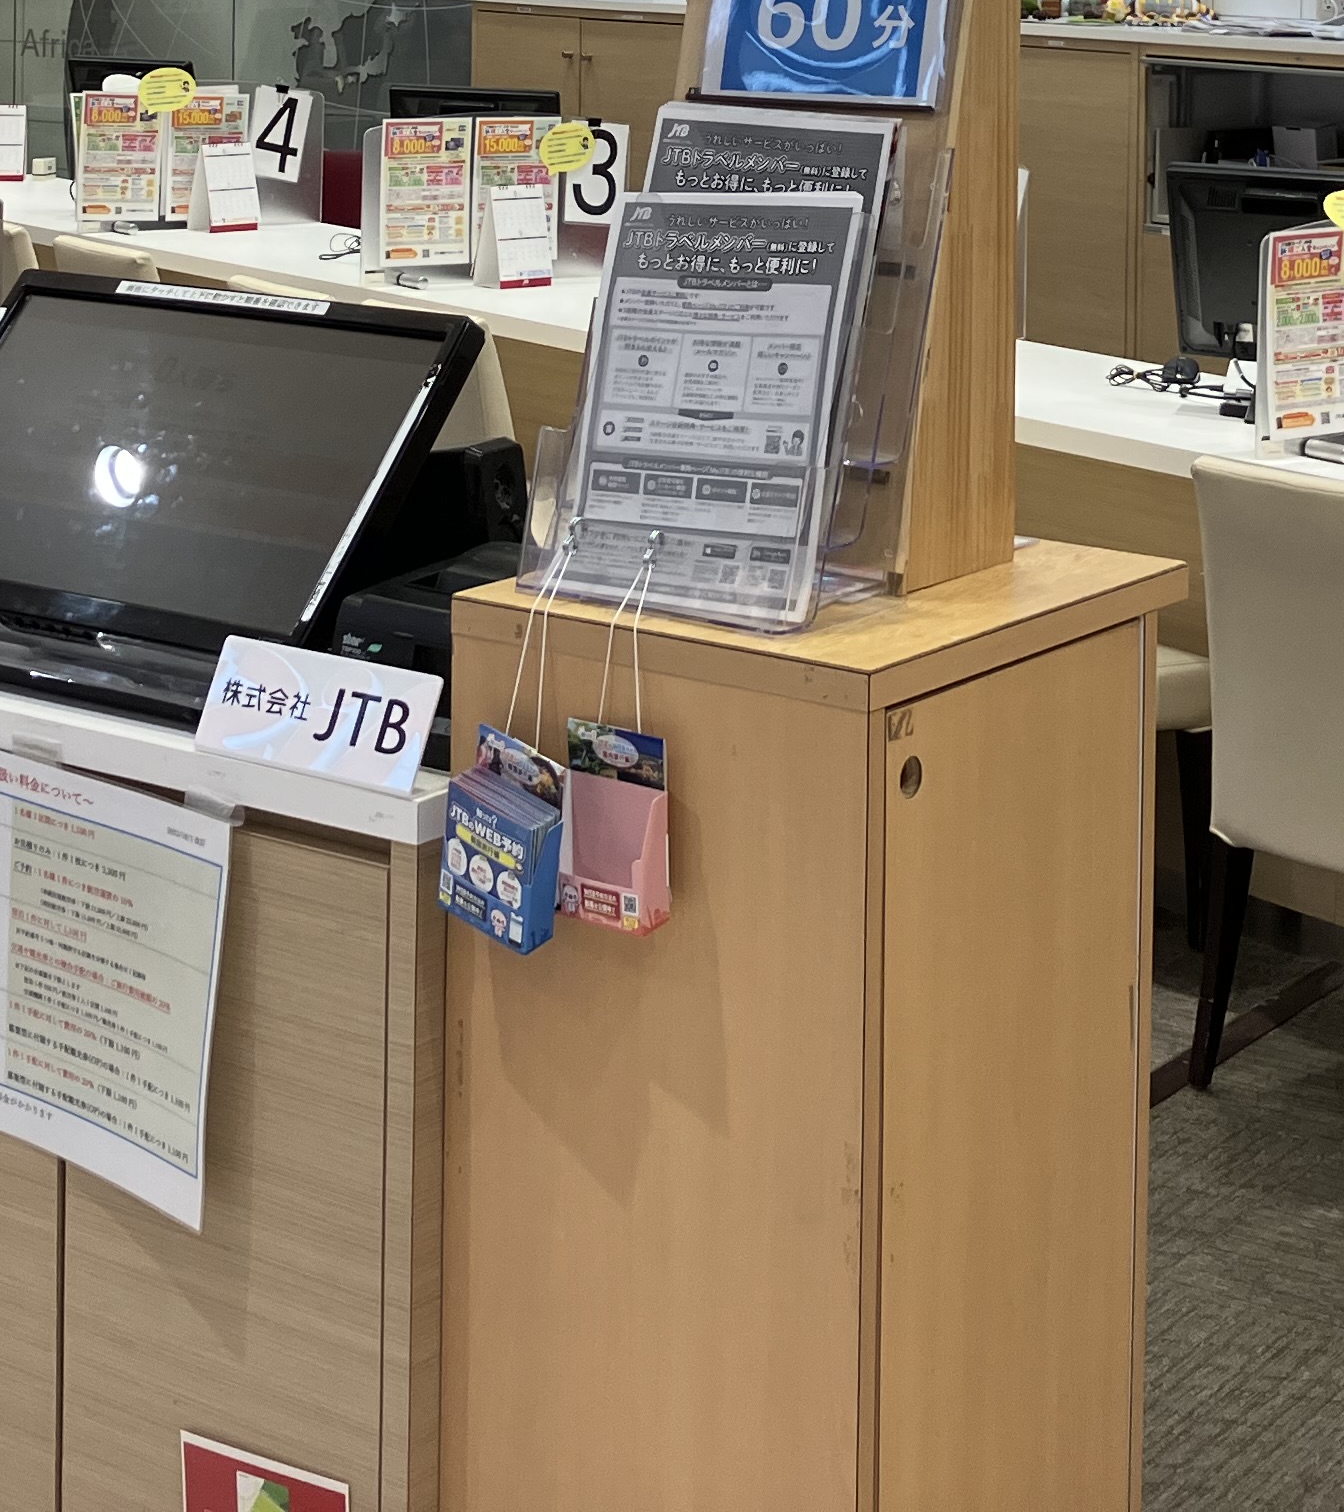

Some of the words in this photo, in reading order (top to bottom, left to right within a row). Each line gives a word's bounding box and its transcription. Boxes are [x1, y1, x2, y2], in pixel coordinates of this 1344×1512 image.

[255, 97, 299, 174] 4
[667, 123, 690, 138] JTB
[572, 130, 618, 216] 3
[629, 206, 653, 221] JTB
[636, 251, 818, 276] もっとお得に、もっと便利に!
[1280, 256, 1321, 280] 8,000
[221, 677, 312, 722] 株式会社
[312, 687, 410, 755] JTB
[450, 803, 525, 861] JTBのWEB予約
